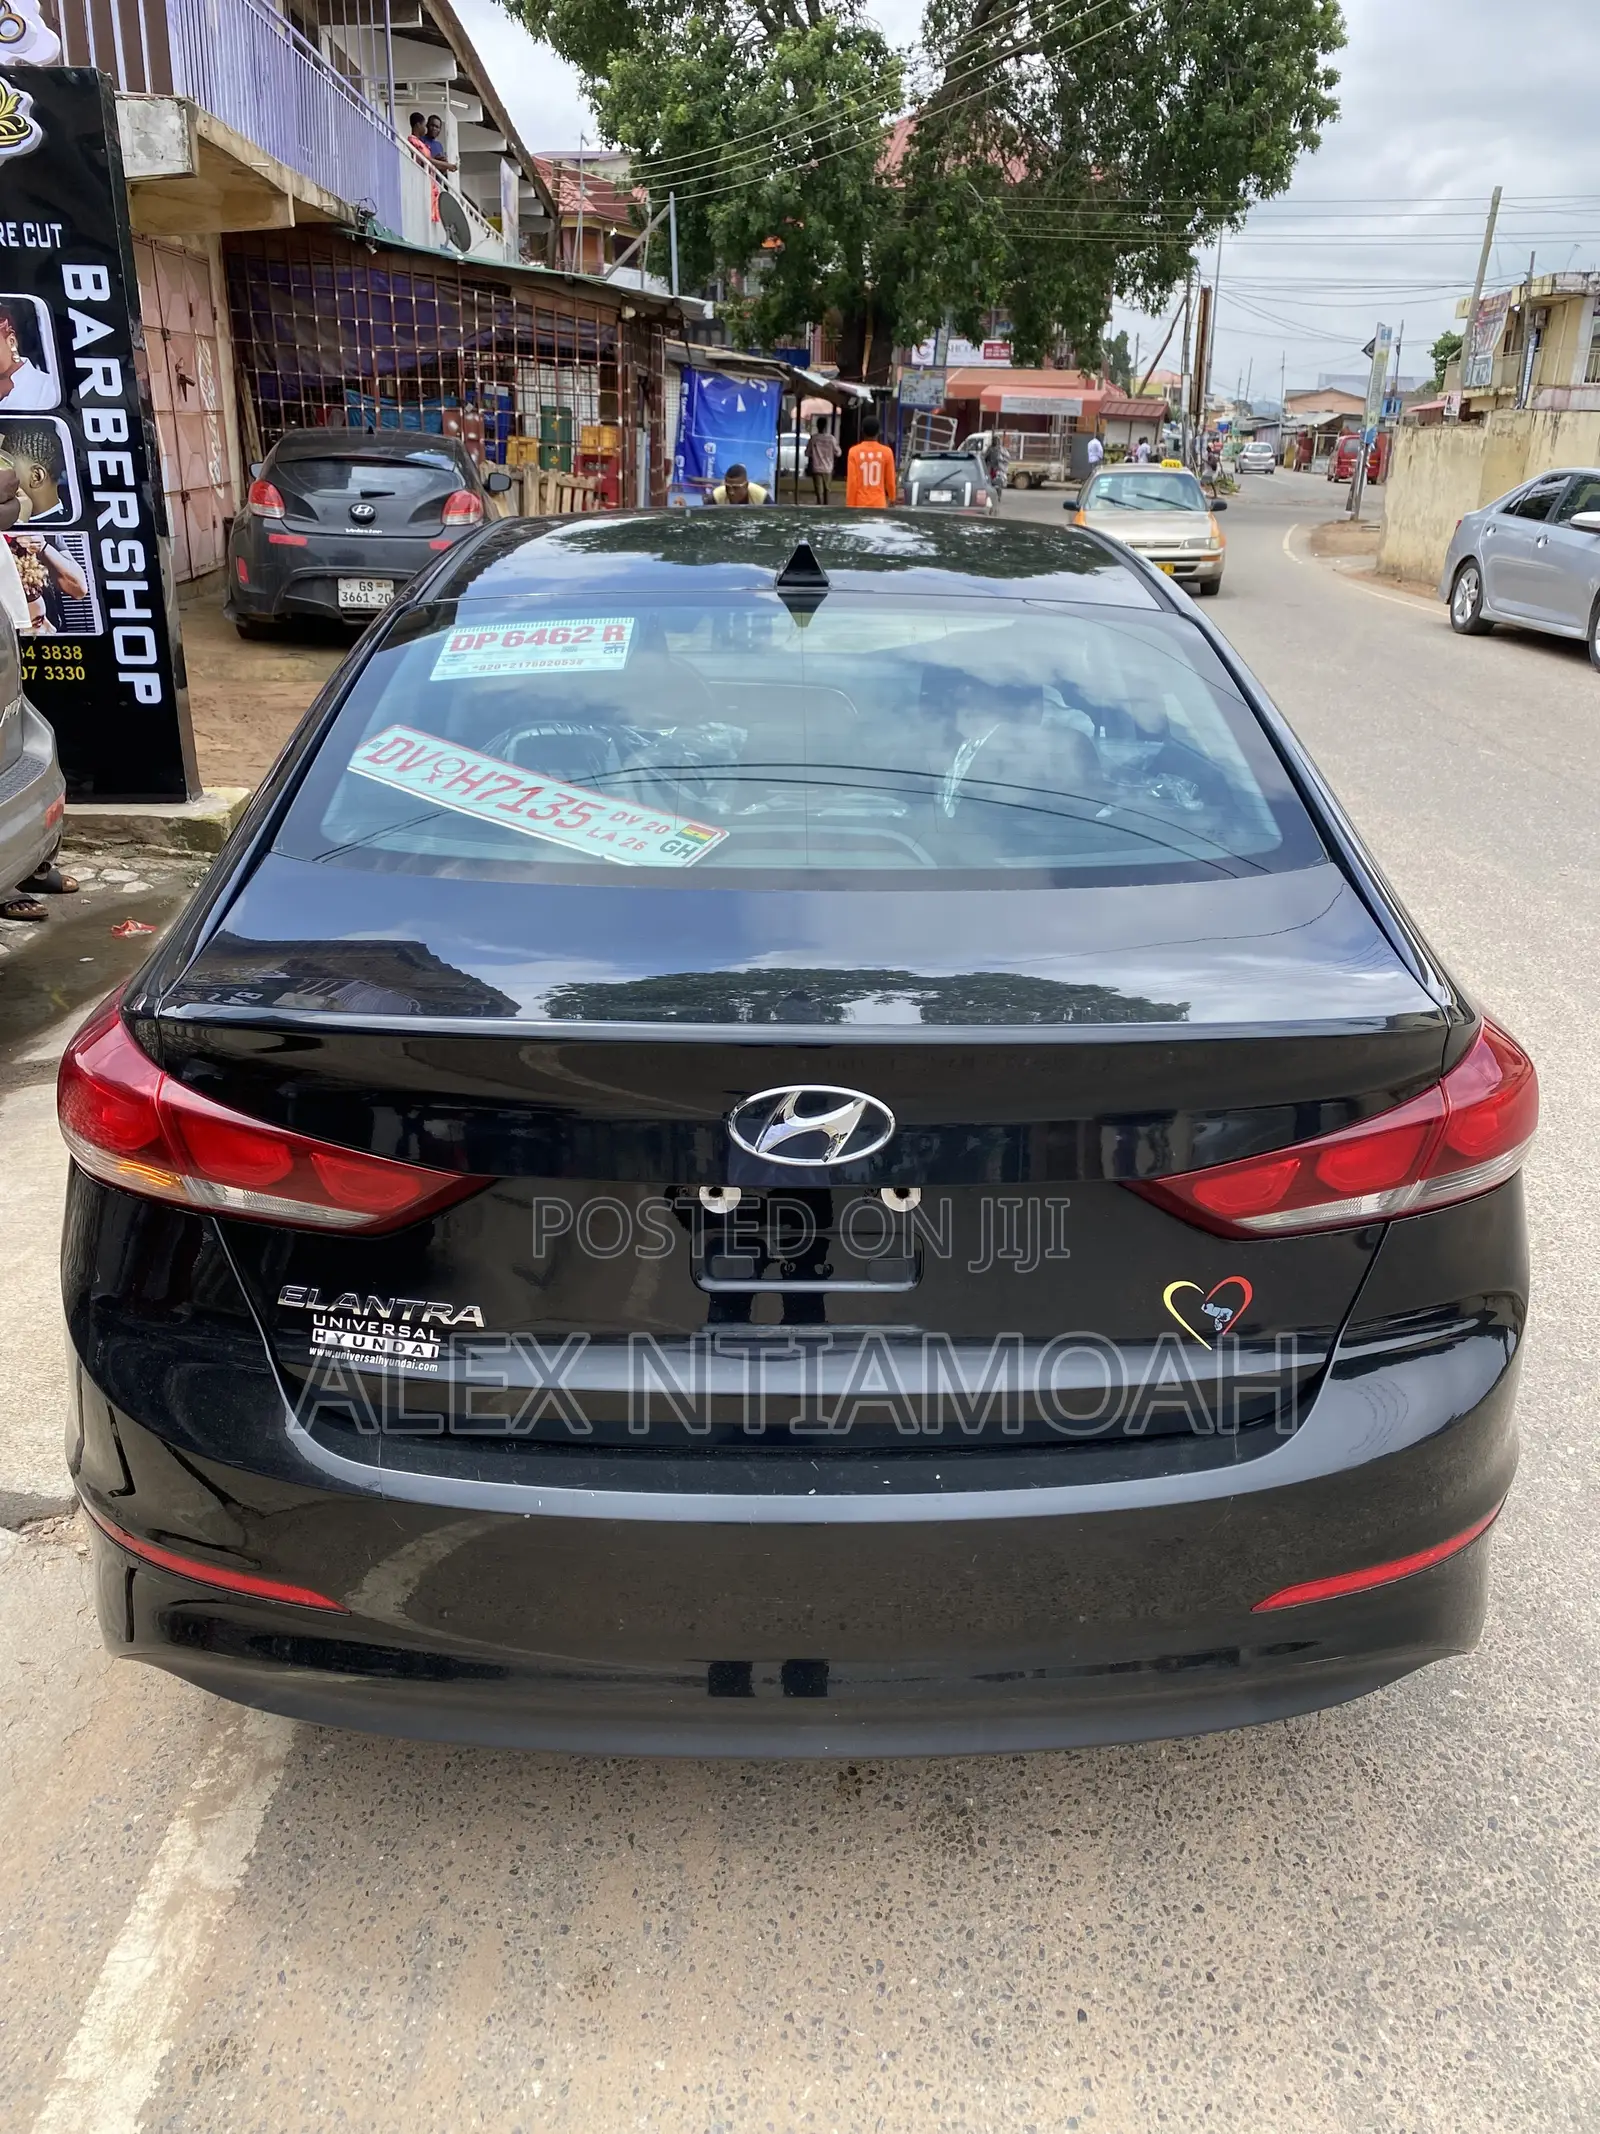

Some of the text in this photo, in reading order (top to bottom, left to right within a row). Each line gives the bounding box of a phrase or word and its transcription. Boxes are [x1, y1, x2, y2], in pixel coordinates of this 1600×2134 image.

[22, 221, 63, 249] CUT
[61, 263, 163, 705] BARBERSHOP
[860, 461, 882, 487] 10
[359, 581, 374, 592] GS
[450, 624, 627, 652] DP 6462 R
[41, 645, 83, 660] 3838
[44, 665, 86, 681] 3330
[641, 821, 671, 835] 20
[618, 837, 649, 851] 26
[659, 839, 699, 860] GH
[277, 1284, 486, 1328] ELANTRA
[312, 1313, 442, 1343] UNIVERSAL
[313, 1329, 439, 1358] HYUNDAI
[309, 1345, 439, 1373] www.universalhyundai.com
